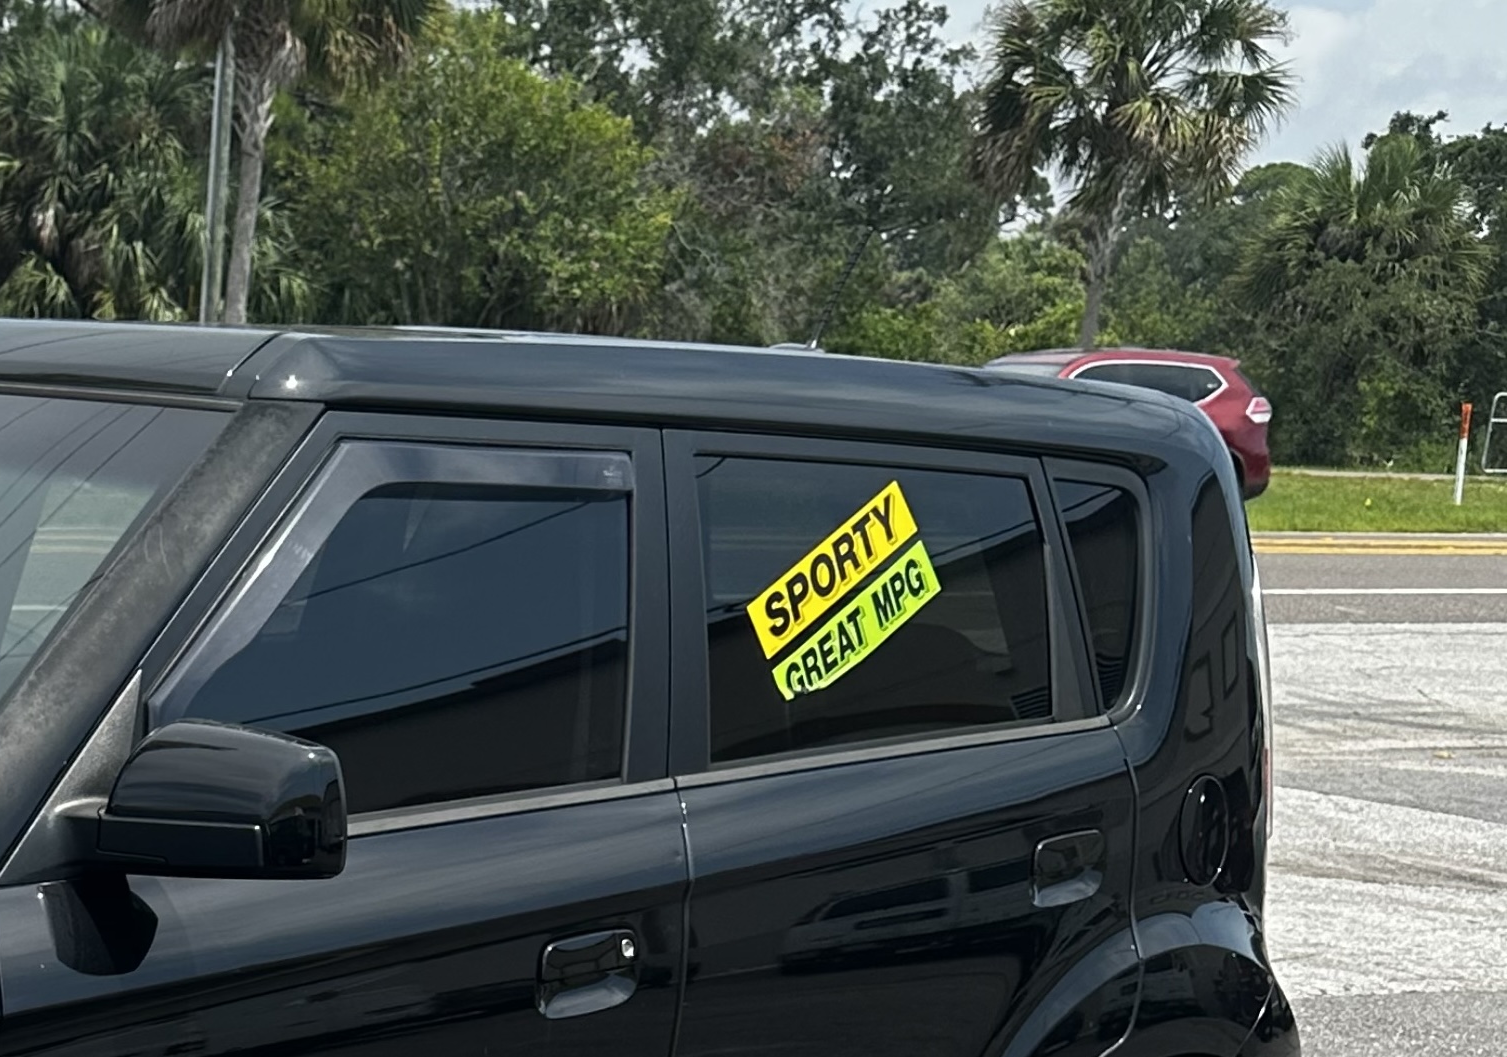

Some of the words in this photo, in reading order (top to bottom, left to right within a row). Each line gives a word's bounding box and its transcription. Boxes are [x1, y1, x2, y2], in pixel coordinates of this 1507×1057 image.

[764, 493, 896, 638] SPORTY
[784, 605, 864, 694] GREAT
[870, 557, 927, 630] MPG
